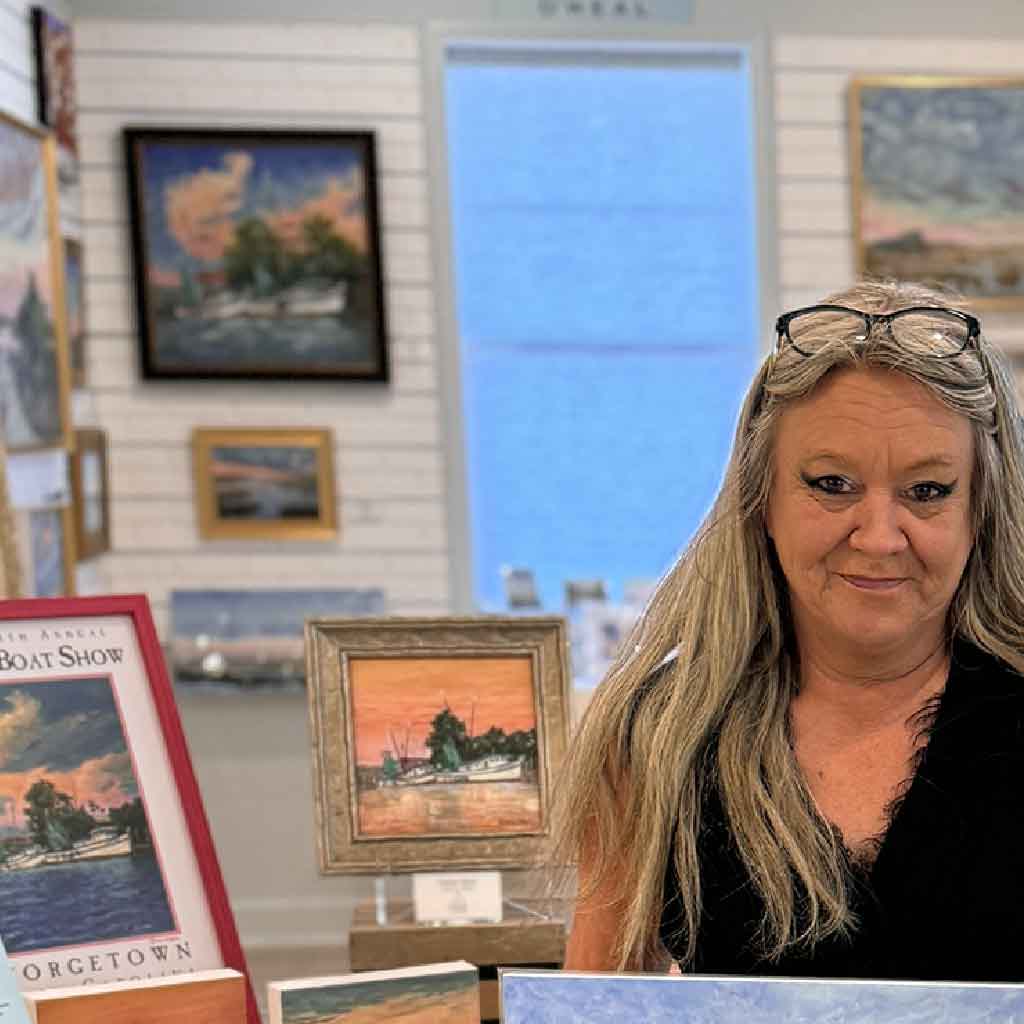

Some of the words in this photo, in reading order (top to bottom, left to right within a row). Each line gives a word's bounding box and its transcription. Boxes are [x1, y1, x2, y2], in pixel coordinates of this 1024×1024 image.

[0, 648, 53, 671] BOAT
[58, 644, 124, 668] SHOW
[10, 941, 193, 982] ORGETOWN
